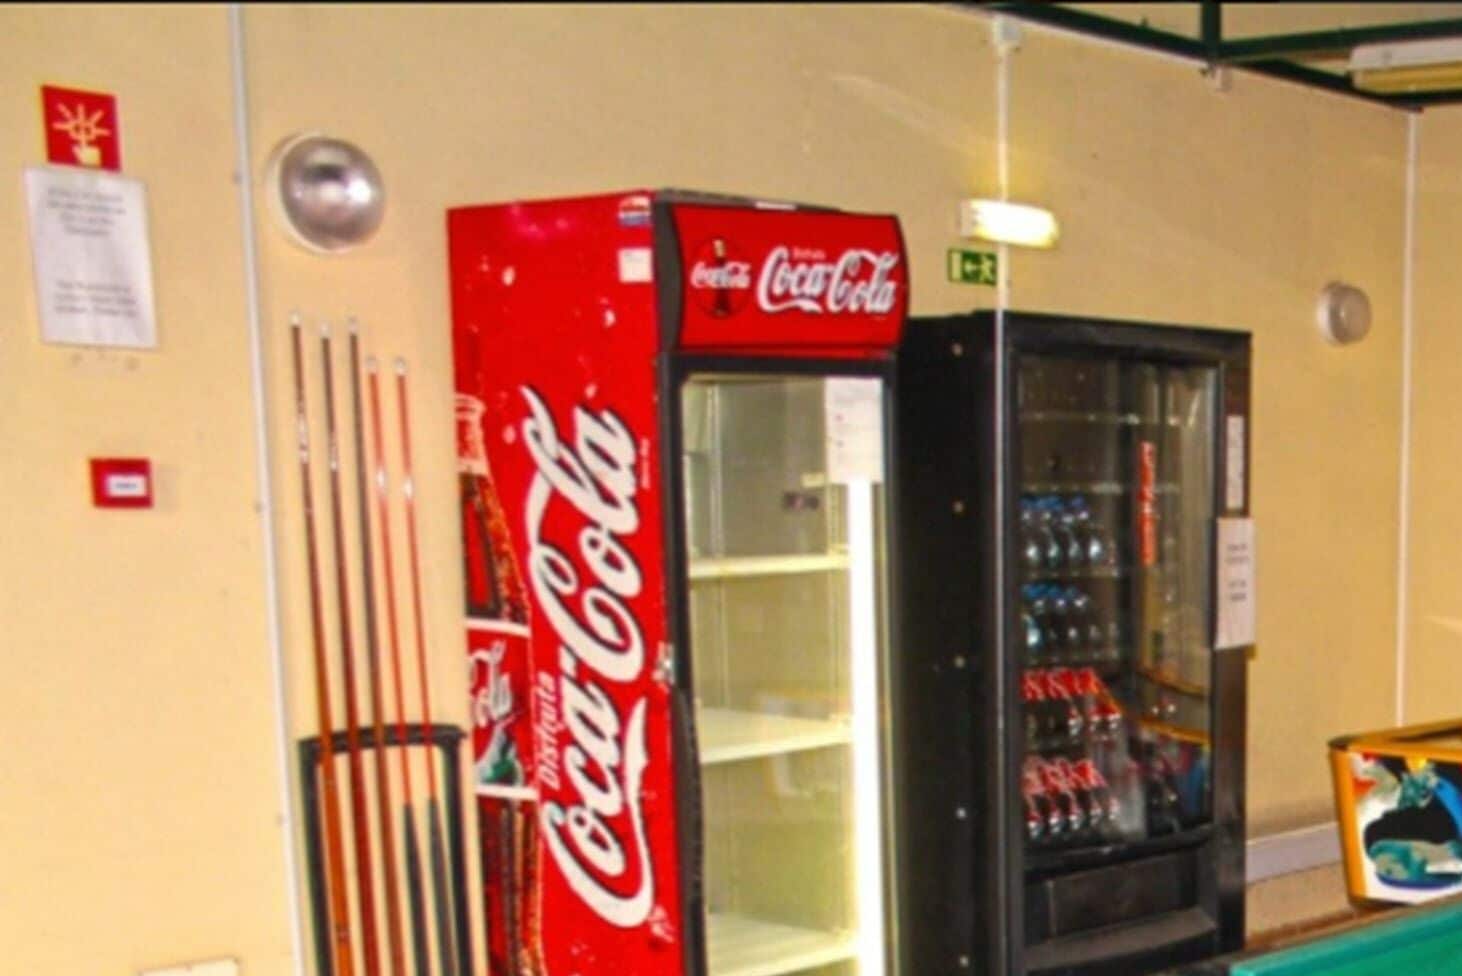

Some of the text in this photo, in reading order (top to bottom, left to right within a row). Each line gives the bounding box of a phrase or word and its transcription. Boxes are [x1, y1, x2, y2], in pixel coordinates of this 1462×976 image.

[757, 246, 898, 315] Coca-Cola
[520, 384, 654, 928] Coca-Cola
[534, 670, 560, 790] Disfruta
